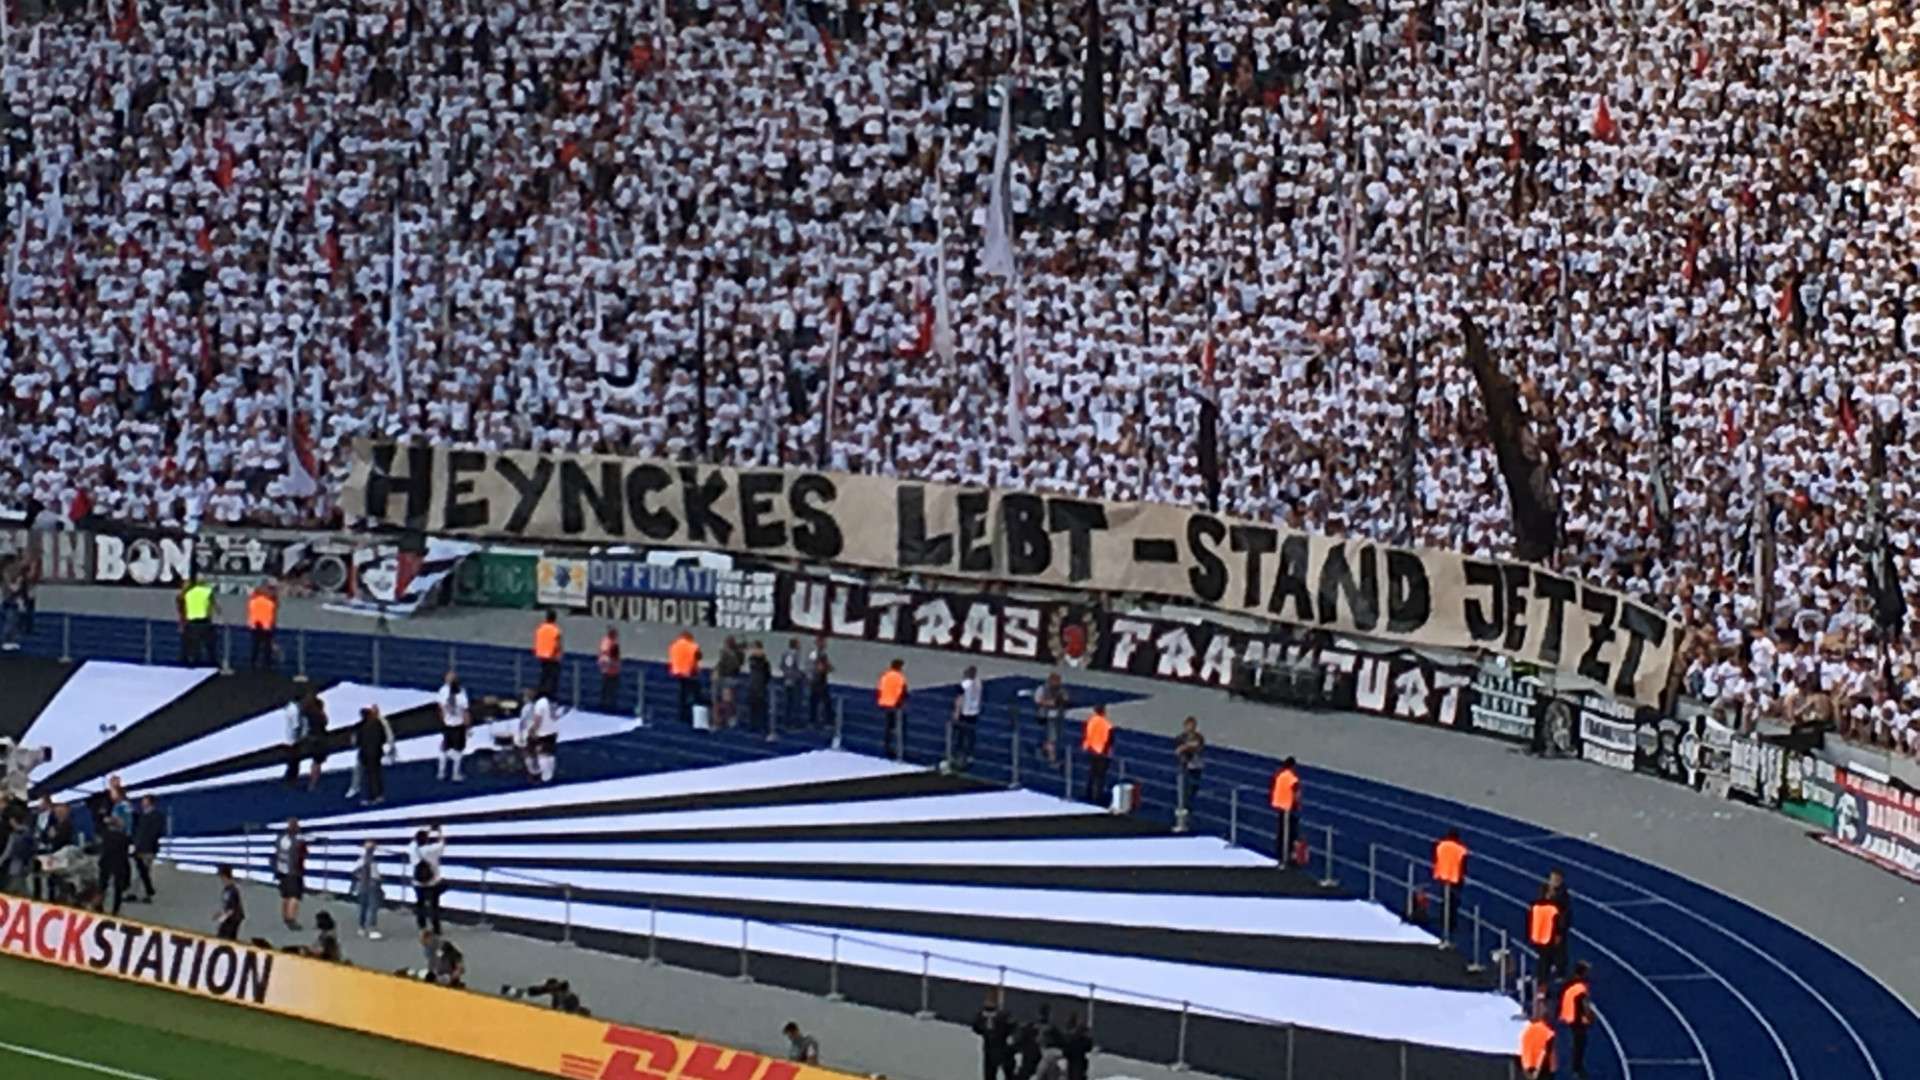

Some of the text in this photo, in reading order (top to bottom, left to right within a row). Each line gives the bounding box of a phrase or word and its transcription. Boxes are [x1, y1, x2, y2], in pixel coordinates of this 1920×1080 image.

[365, 441, 844, 558] HEYNCKES
[897, 485, 1108, 582] LEBT
[1463, 560, 1667, 697] JETZT
[790, 581, 1041, 657] ULTRAS
[0, 897, 274, 1004] ACKSTATION
